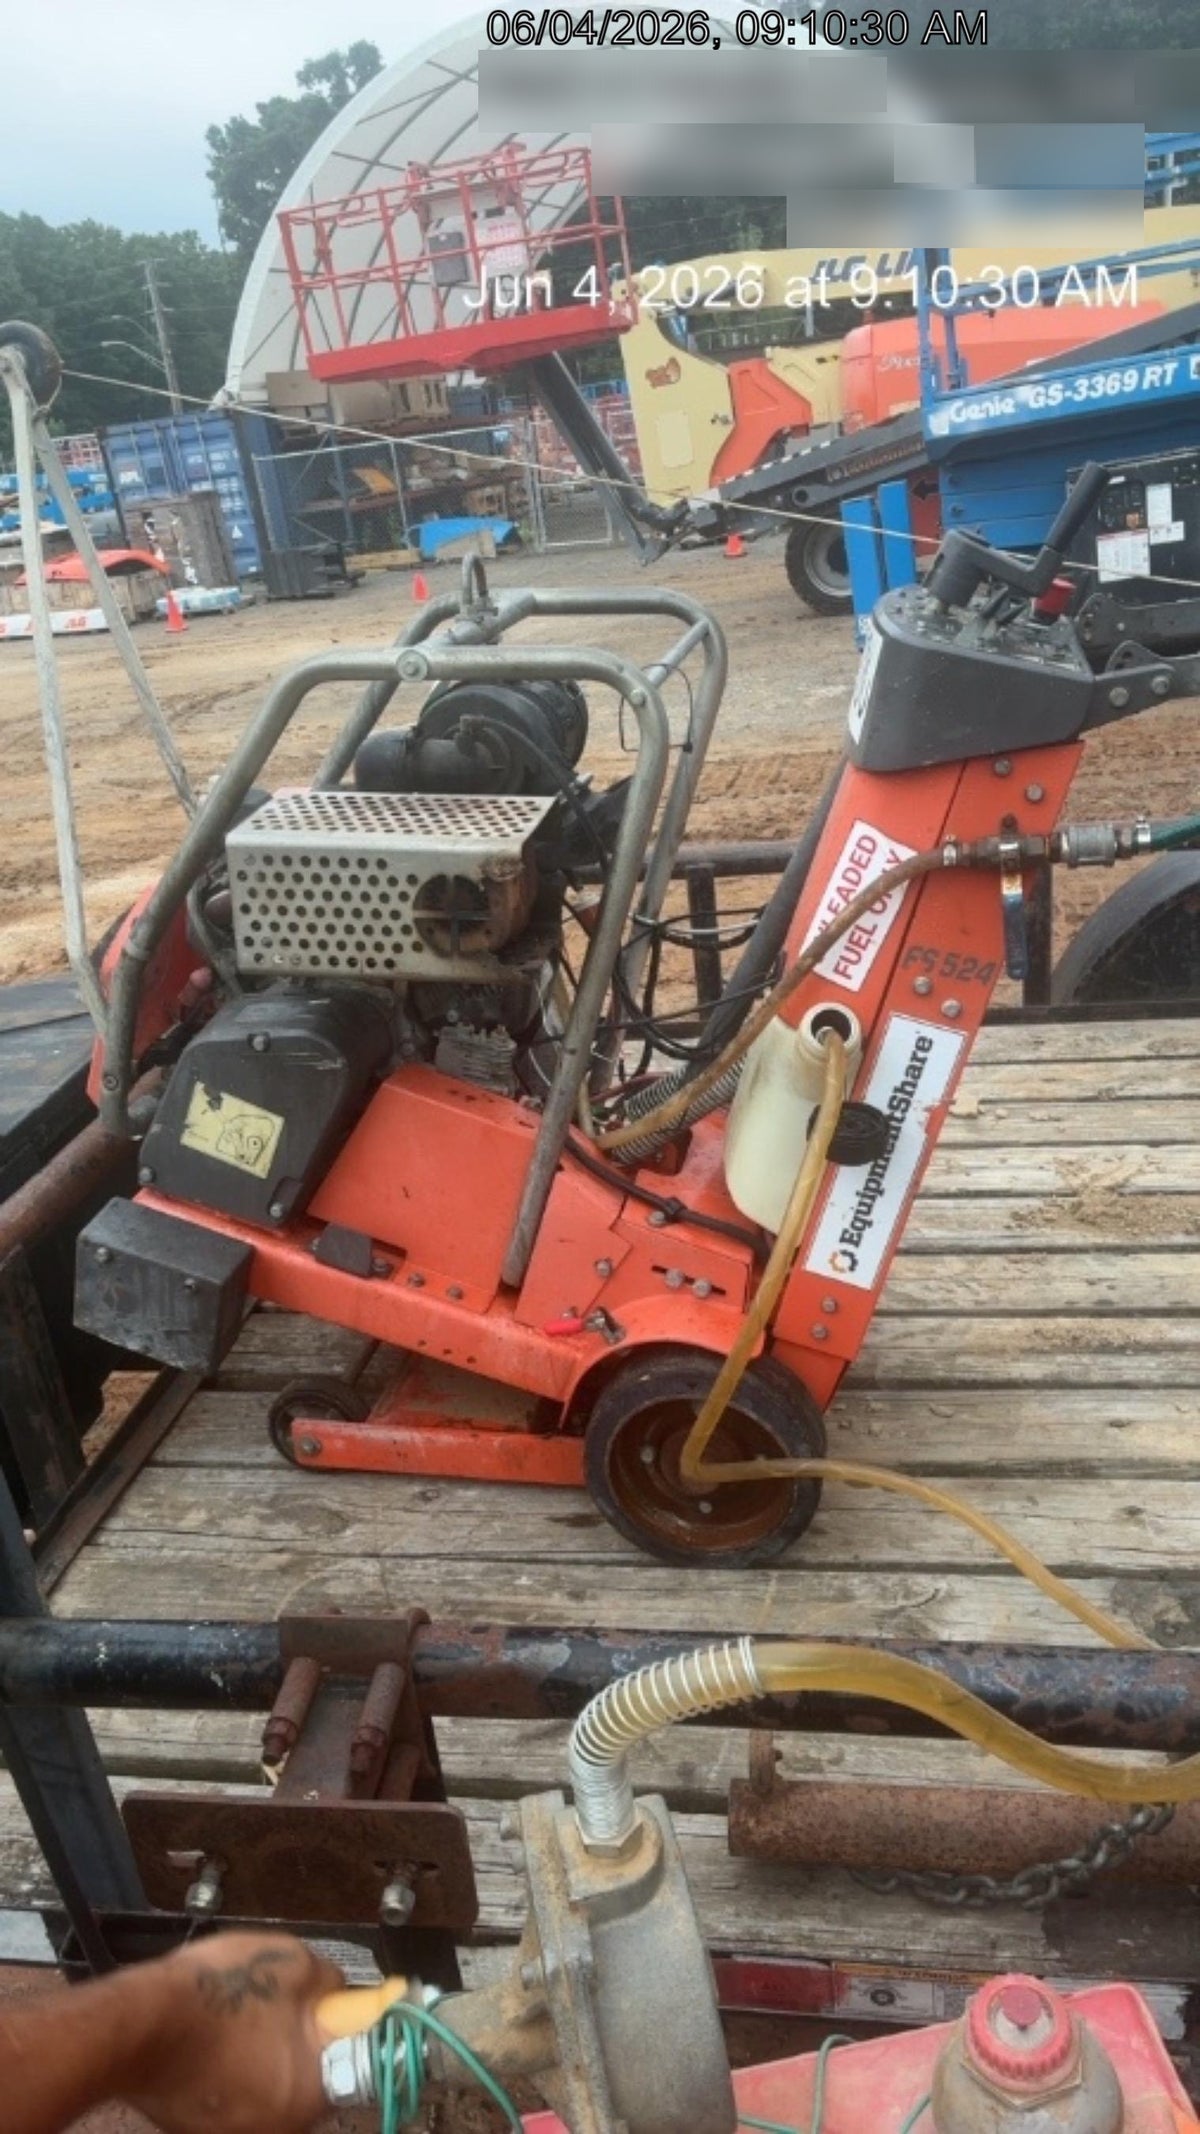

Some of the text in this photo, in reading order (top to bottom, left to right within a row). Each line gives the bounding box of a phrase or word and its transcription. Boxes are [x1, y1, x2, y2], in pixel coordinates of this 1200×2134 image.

[949, 360, 1179, 424] Genie GS-3369 RT
[833, 922, 879, 980] FUEL
[839, 1034, 934, 1248] EquipmentShare
